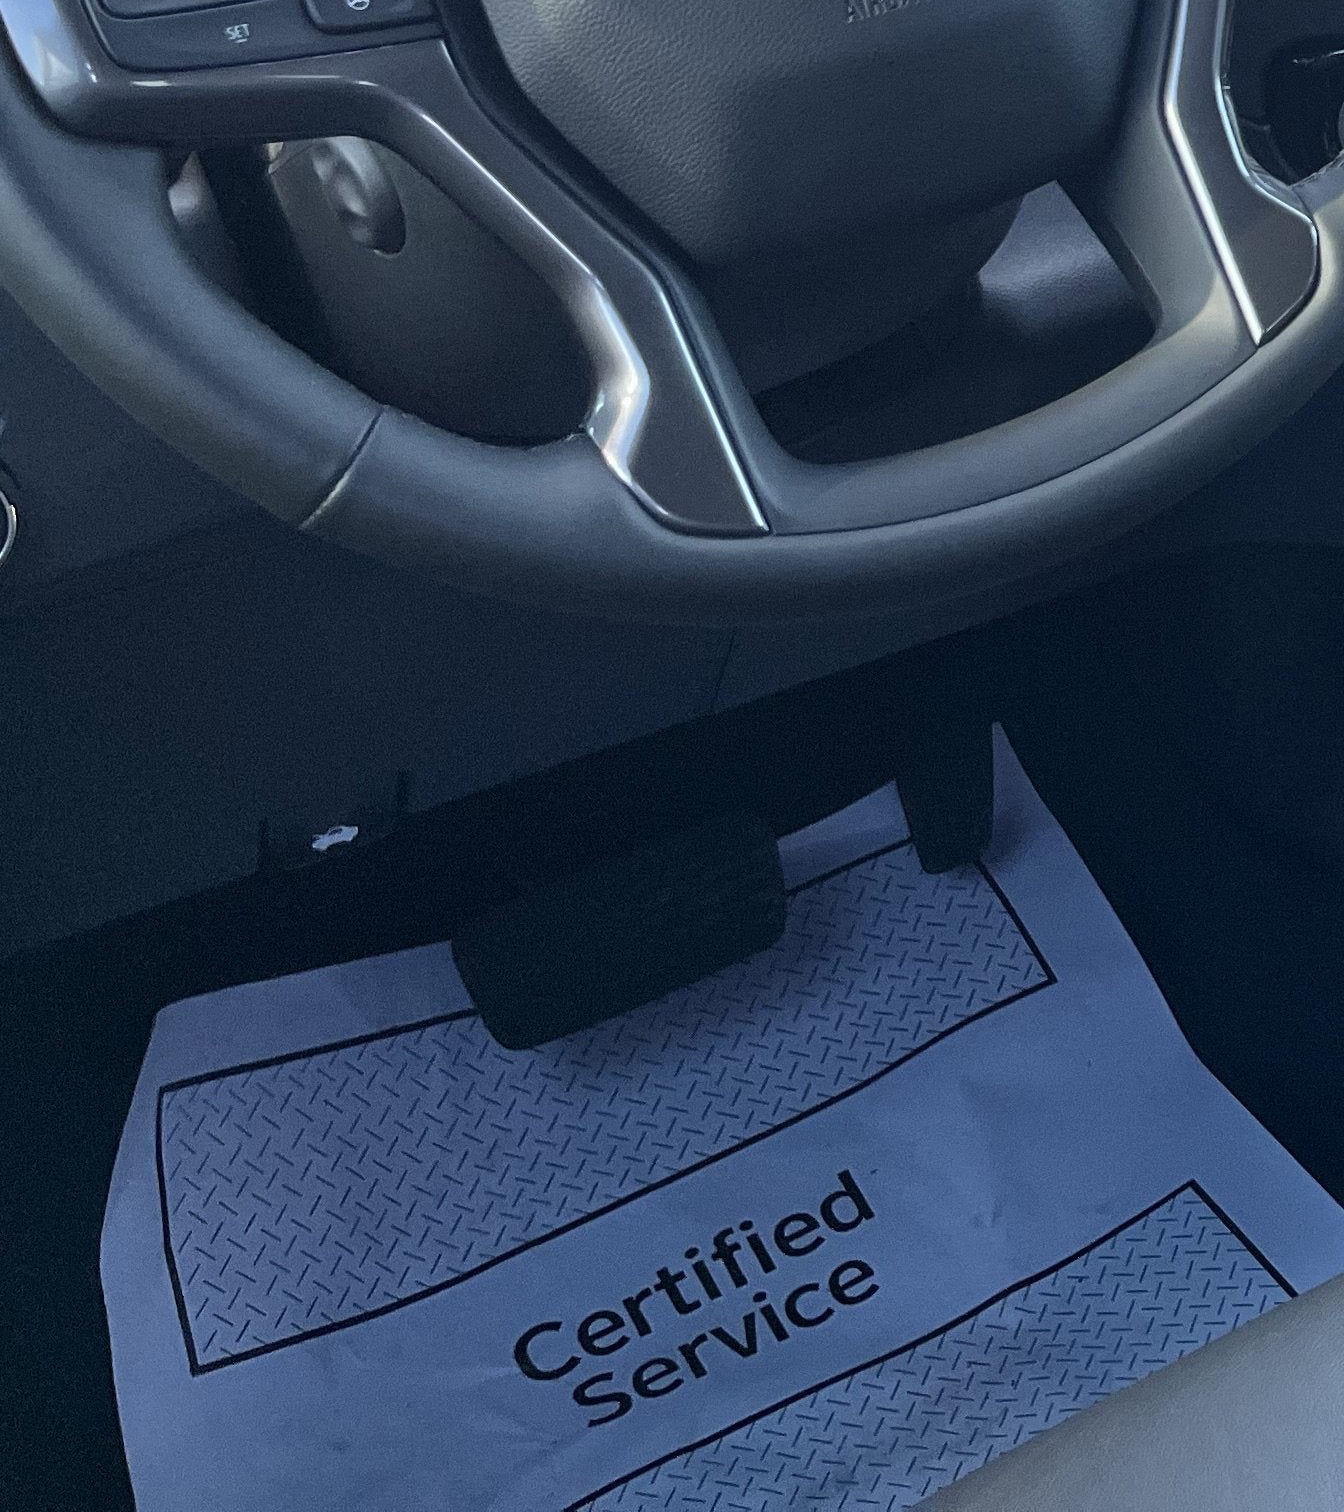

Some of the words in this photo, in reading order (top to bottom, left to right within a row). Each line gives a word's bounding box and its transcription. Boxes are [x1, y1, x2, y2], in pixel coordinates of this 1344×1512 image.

[225, 23, 249, 40] SET
[513, 1169, 876, 1381] Certified
[572, 1257, 881, 1428] Service
